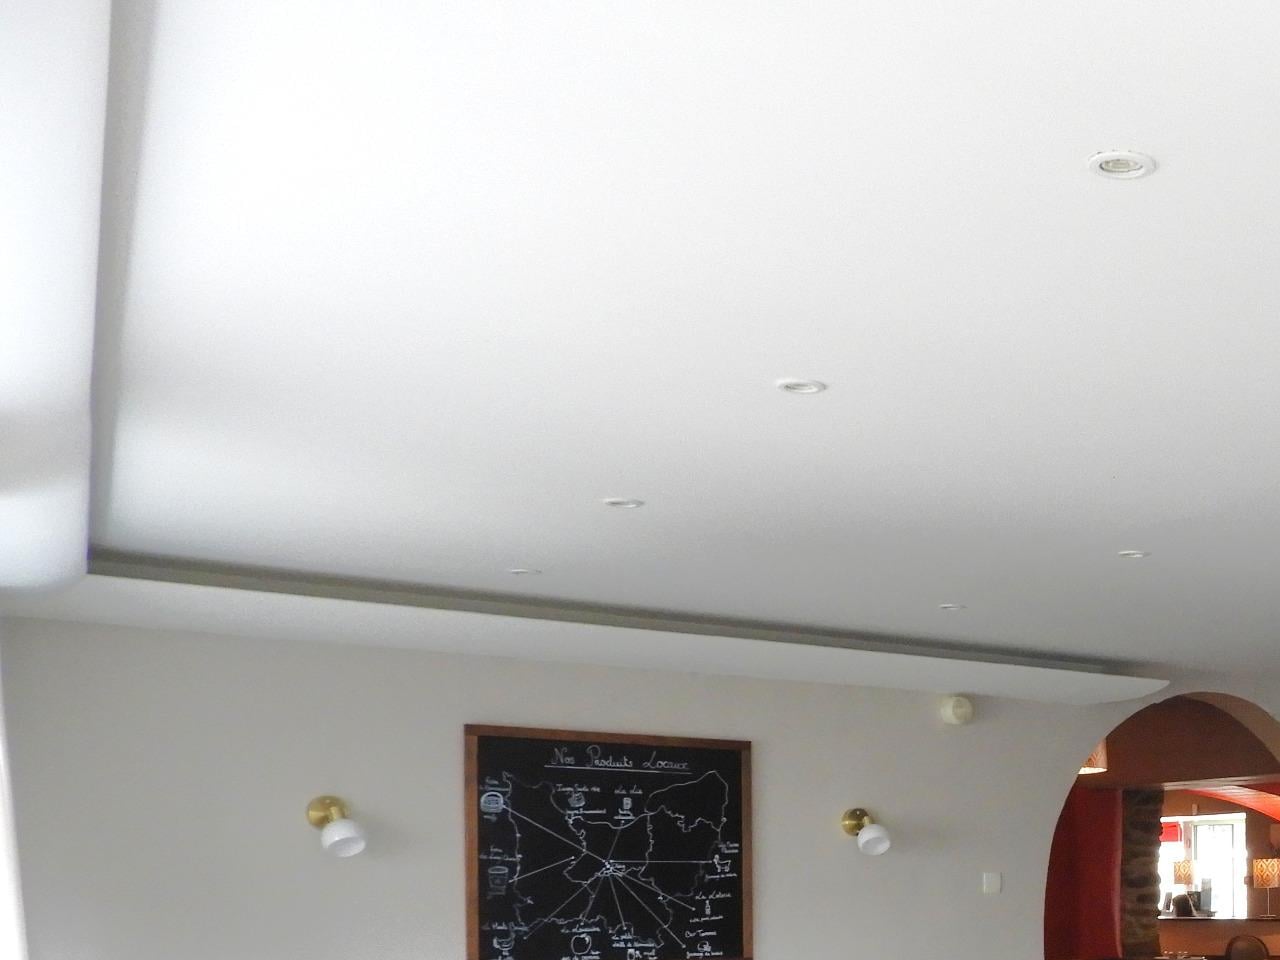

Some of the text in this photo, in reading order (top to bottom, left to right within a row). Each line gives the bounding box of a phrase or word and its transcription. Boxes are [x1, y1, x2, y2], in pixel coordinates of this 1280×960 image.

[551, 744, 690, 769] Nos Produits Locaux
